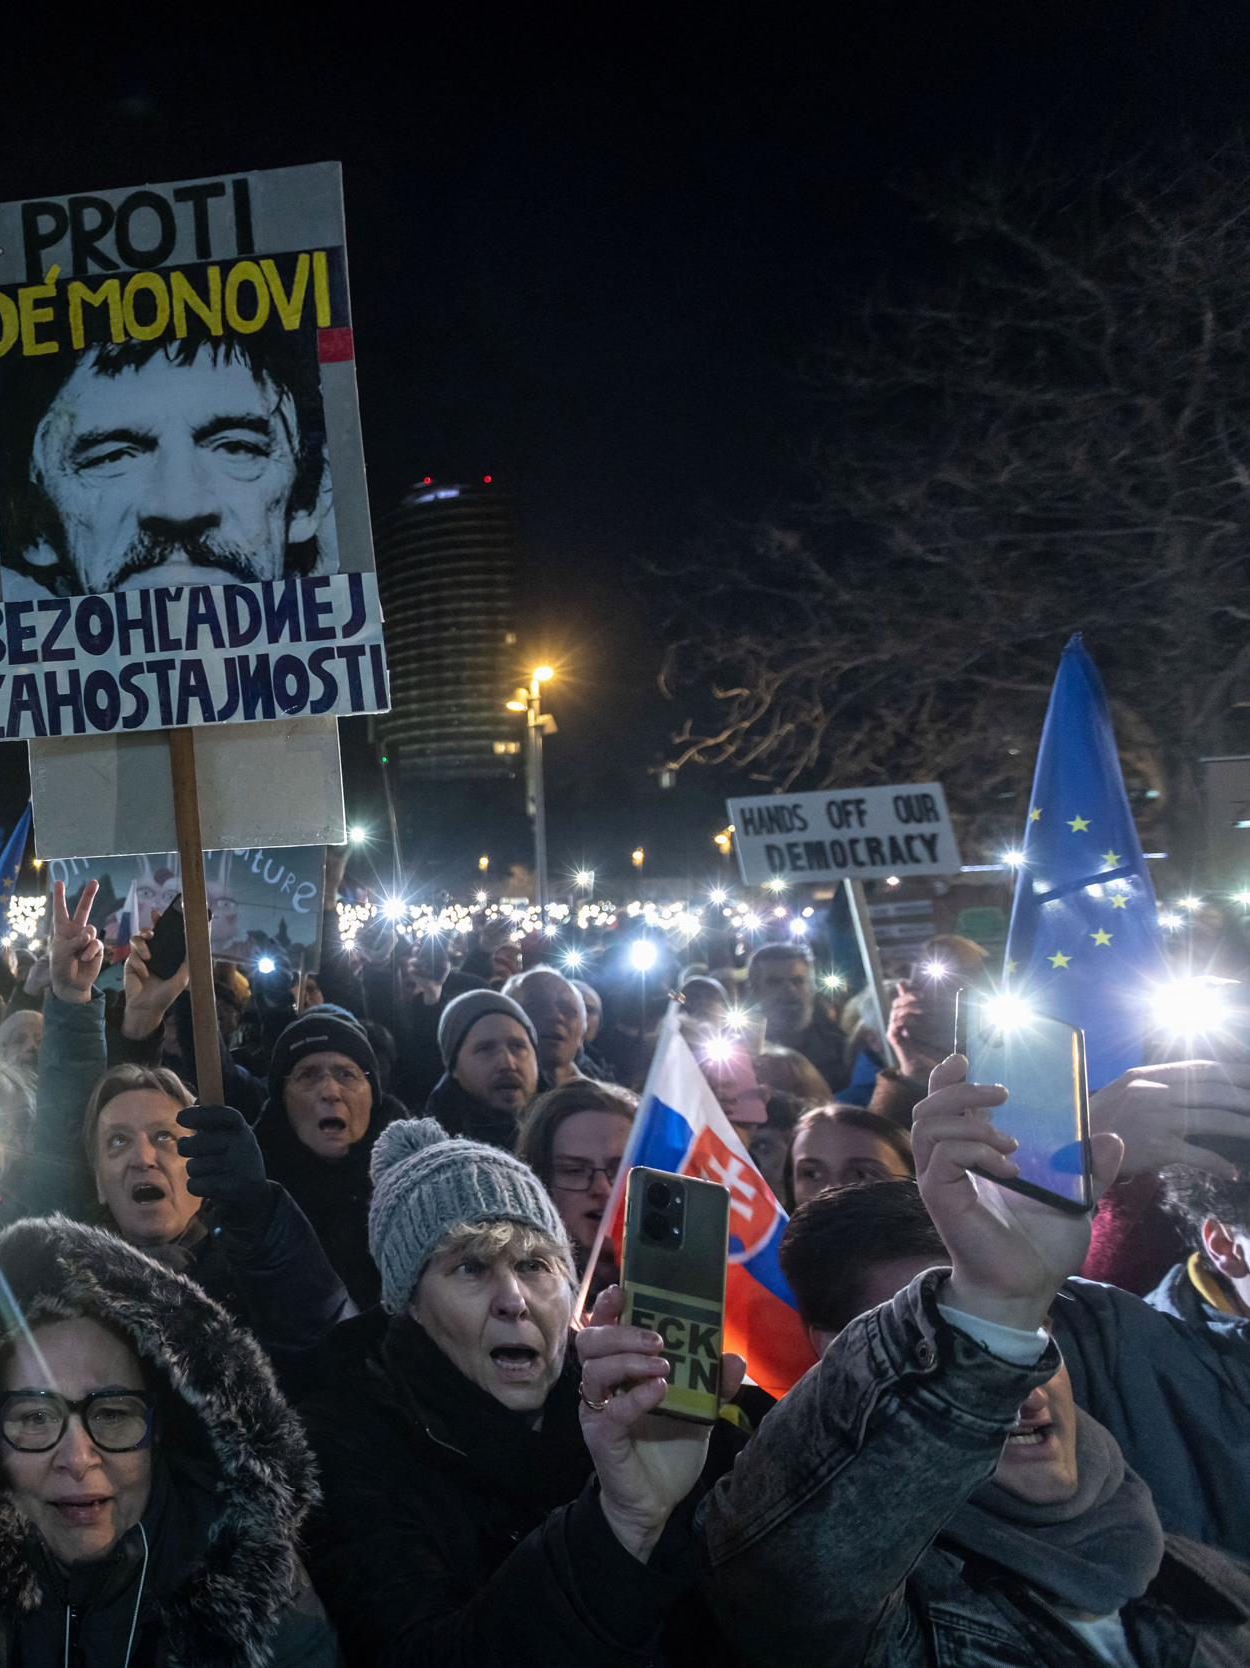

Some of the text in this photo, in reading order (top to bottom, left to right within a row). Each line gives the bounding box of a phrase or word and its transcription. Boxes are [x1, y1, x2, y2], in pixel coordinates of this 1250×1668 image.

[21, 177, 255, 283] PROTI
[740, 793, 940, 835] HANDS OFF OUR
[764, 832, 940, 874] DEMOCRACY
